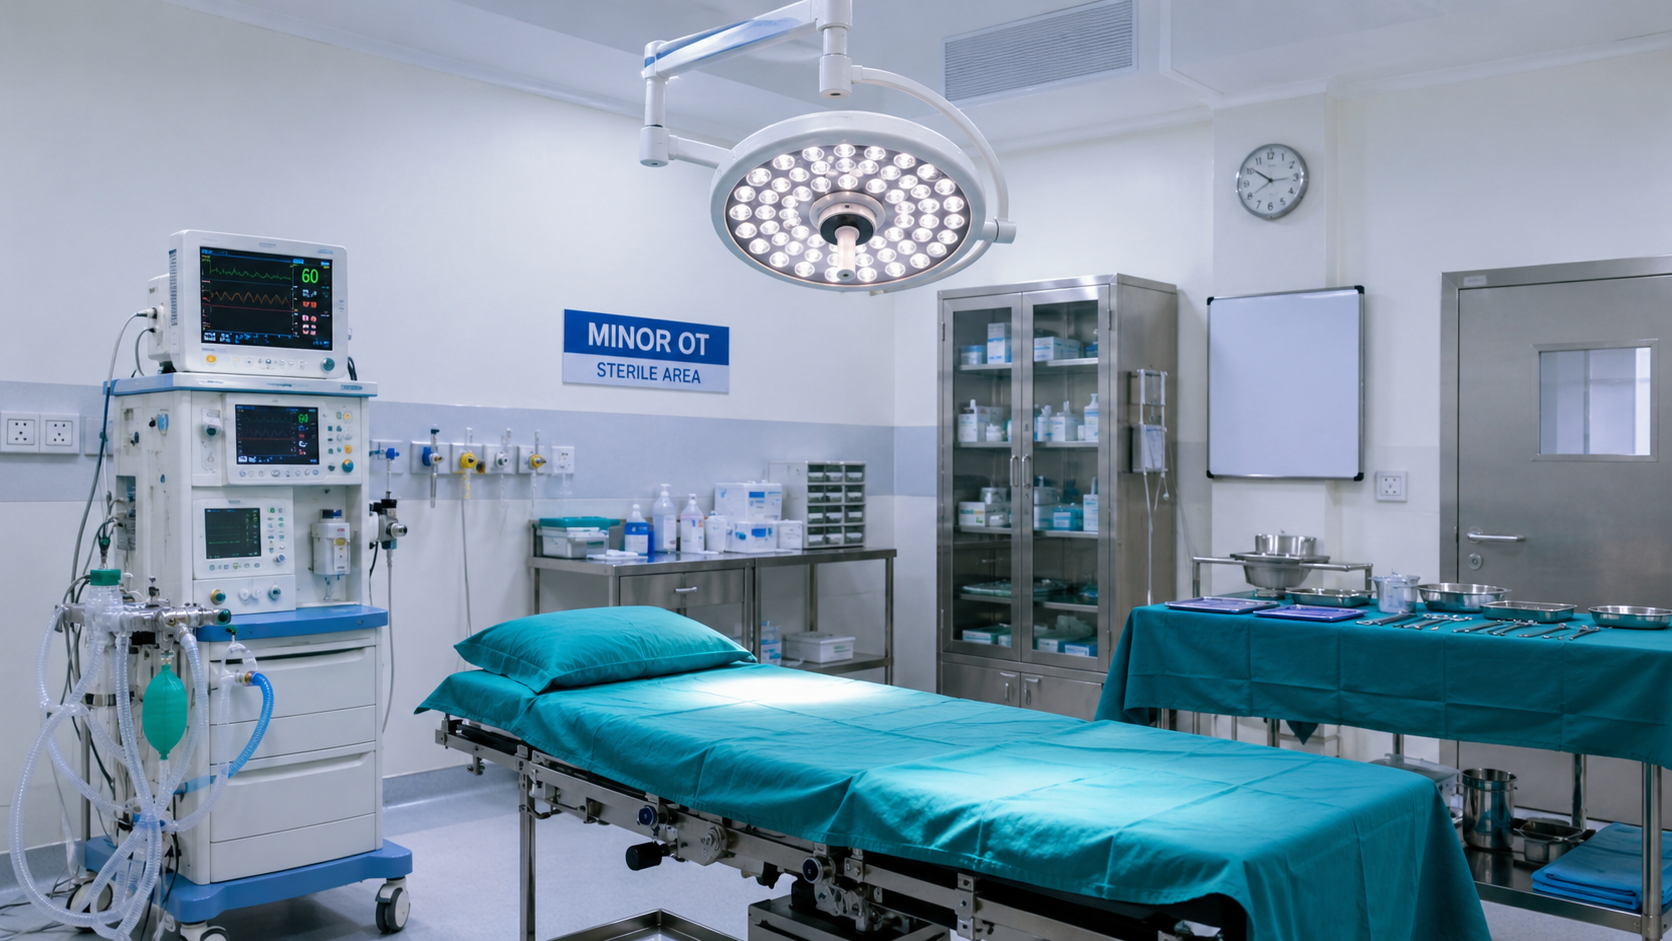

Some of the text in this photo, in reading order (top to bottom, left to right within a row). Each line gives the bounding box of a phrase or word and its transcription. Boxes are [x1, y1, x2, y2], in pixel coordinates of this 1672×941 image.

[1255, 156, 1262, 165] 11
[1267, 152, 1275, 160] 12
[1289, 160, 1295, 169] 2
[1292, 173, 1299, 182] 3
[1256, 200, 1262, 210] 7
[1280, 197, 1286, 206] 5
[1267, 202, 1274, 211] 6
[301, 268, 319, 284] 60
[588, 321, 710, 356] MINOR OT
[597, 361, 701, 384] STERILE AREA
